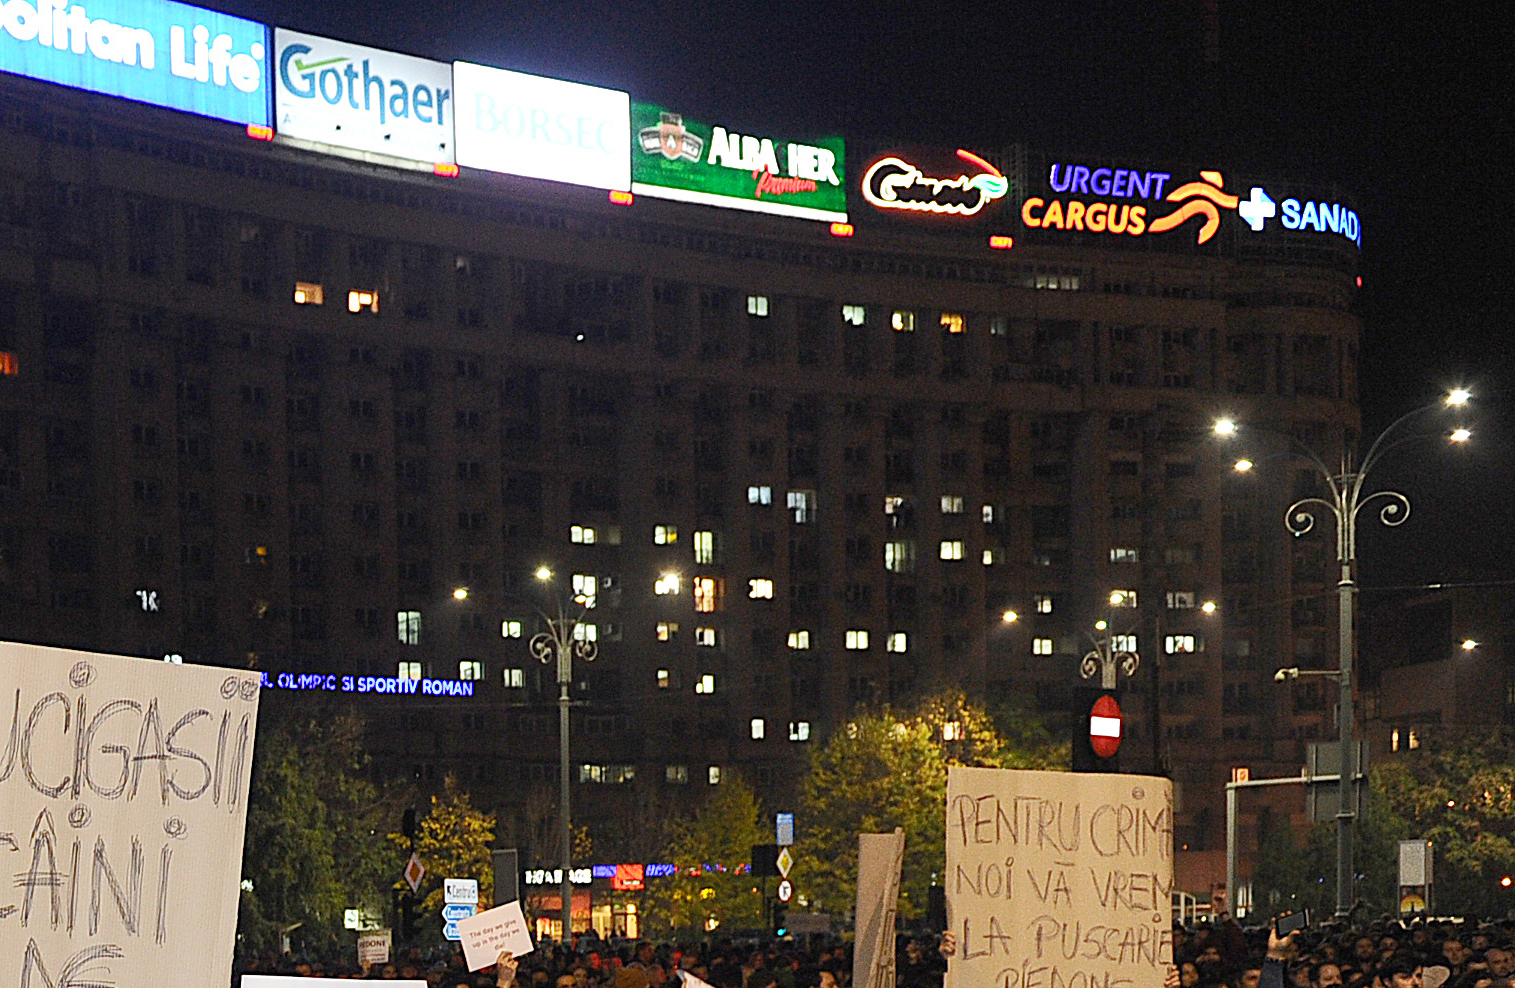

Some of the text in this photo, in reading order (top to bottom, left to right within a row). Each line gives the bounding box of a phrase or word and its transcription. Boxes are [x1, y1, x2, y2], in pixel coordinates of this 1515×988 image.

[170, 24, 261, 93] Life
[279, 43, 450, 126] Gothaer
[751, 166, 818, 198] Premium
[1049, 163, 1171, 200] URGENT
[1022, 197, 1147, 236] CARGUS
[1281, 198, 1362, 247] SANAD
[341, 676, 354, 692] SI
[357, 677, 419, 694] SPORTIV
[422, 679, 474, 697] ROMAN
[952, 794, 1081, 853] PENTRU
[956, 857, 1015, 901] NOI
[963, 913, 1173, 968] LA PUSCARIE
